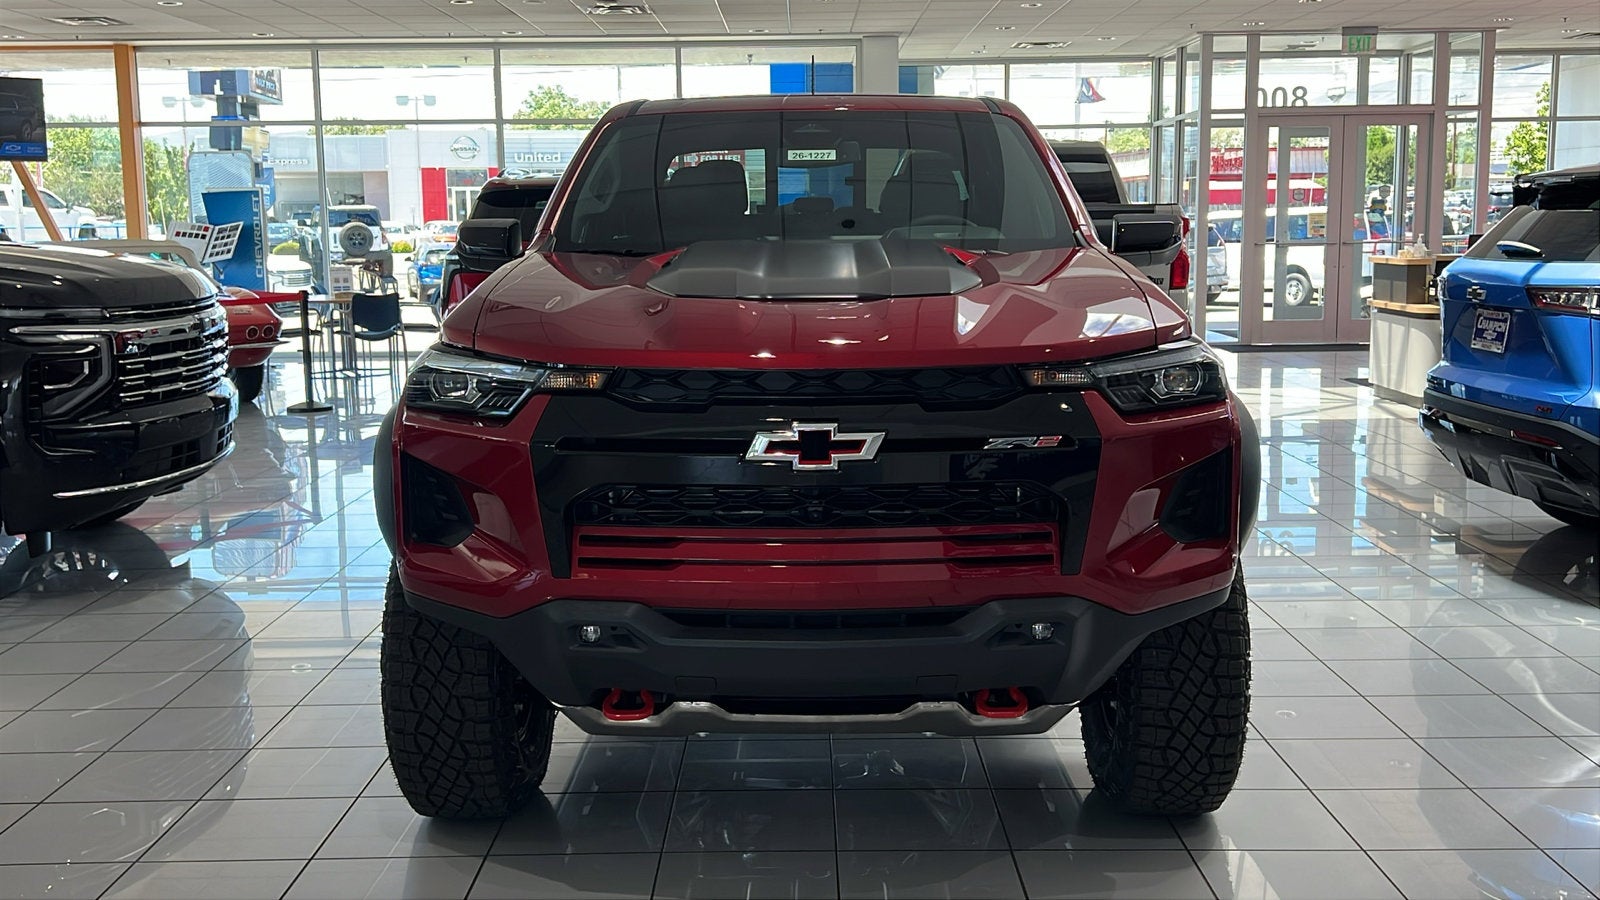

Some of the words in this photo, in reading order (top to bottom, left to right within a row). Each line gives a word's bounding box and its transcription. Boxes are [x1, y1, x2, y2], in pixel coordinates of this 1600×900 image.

[1348, 35, 1371, 52] EXIT
[514, 152, 561, 163] United
[791, 151, 832, 160] 26-1227
[251, 194, 264, 278] CHEVROLET
[1477, 315, 1508, 333] CHAMPION
[983, 436, 1063, 450] ZR2
